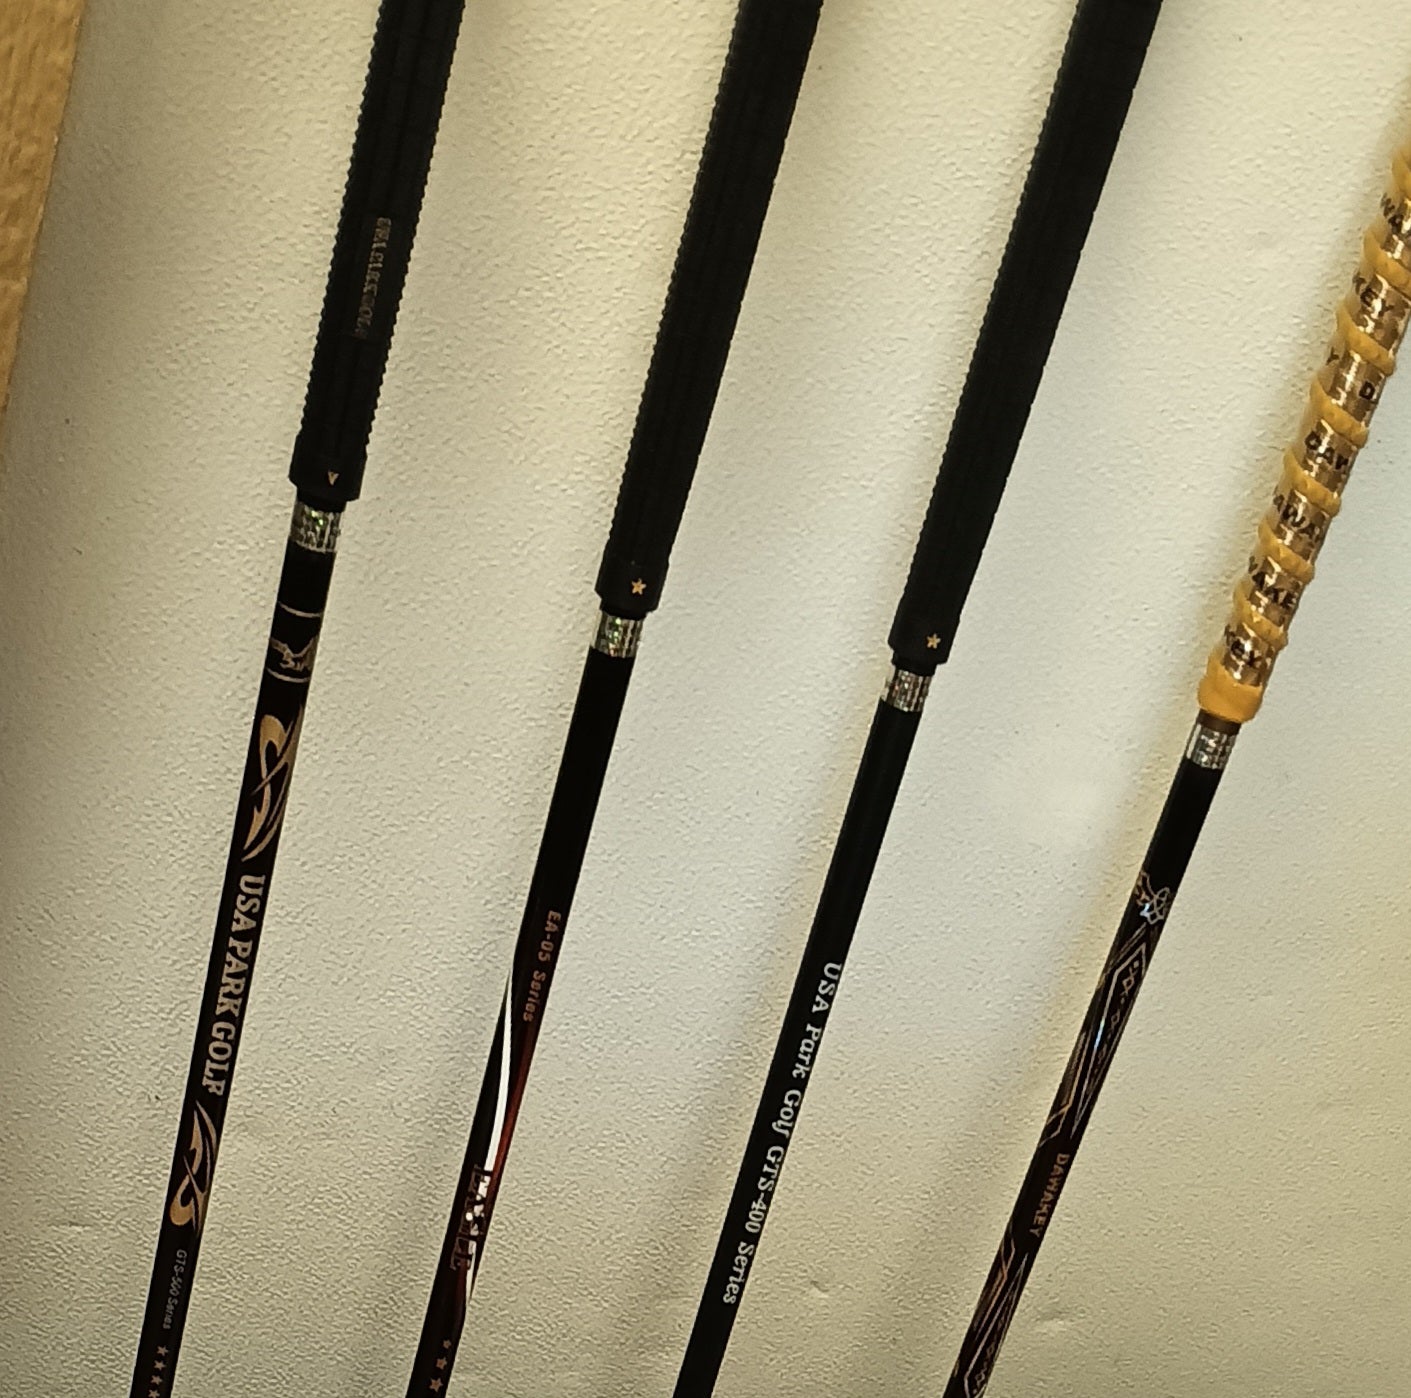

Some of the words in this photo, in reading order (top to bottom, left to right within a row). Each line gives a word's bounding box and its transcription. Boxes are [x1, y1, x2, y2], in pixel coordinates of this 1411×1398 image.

[231, 874, 266, 932] USA
[538, 910, 562, 962] EA-05
[215, 936, 253, 1017] PARK
[523, 970, 547, 1023] Series
[811, 962, 841, 1013] USA
[202, 1021, 236, 1096] GOLF
[792, 1023, 822, 1079] Park
[772, 1089, 801, 1139] Golf
[745, 1145, 784, 1235] GTS-400
[723, 1241, 755, 1304] Series
